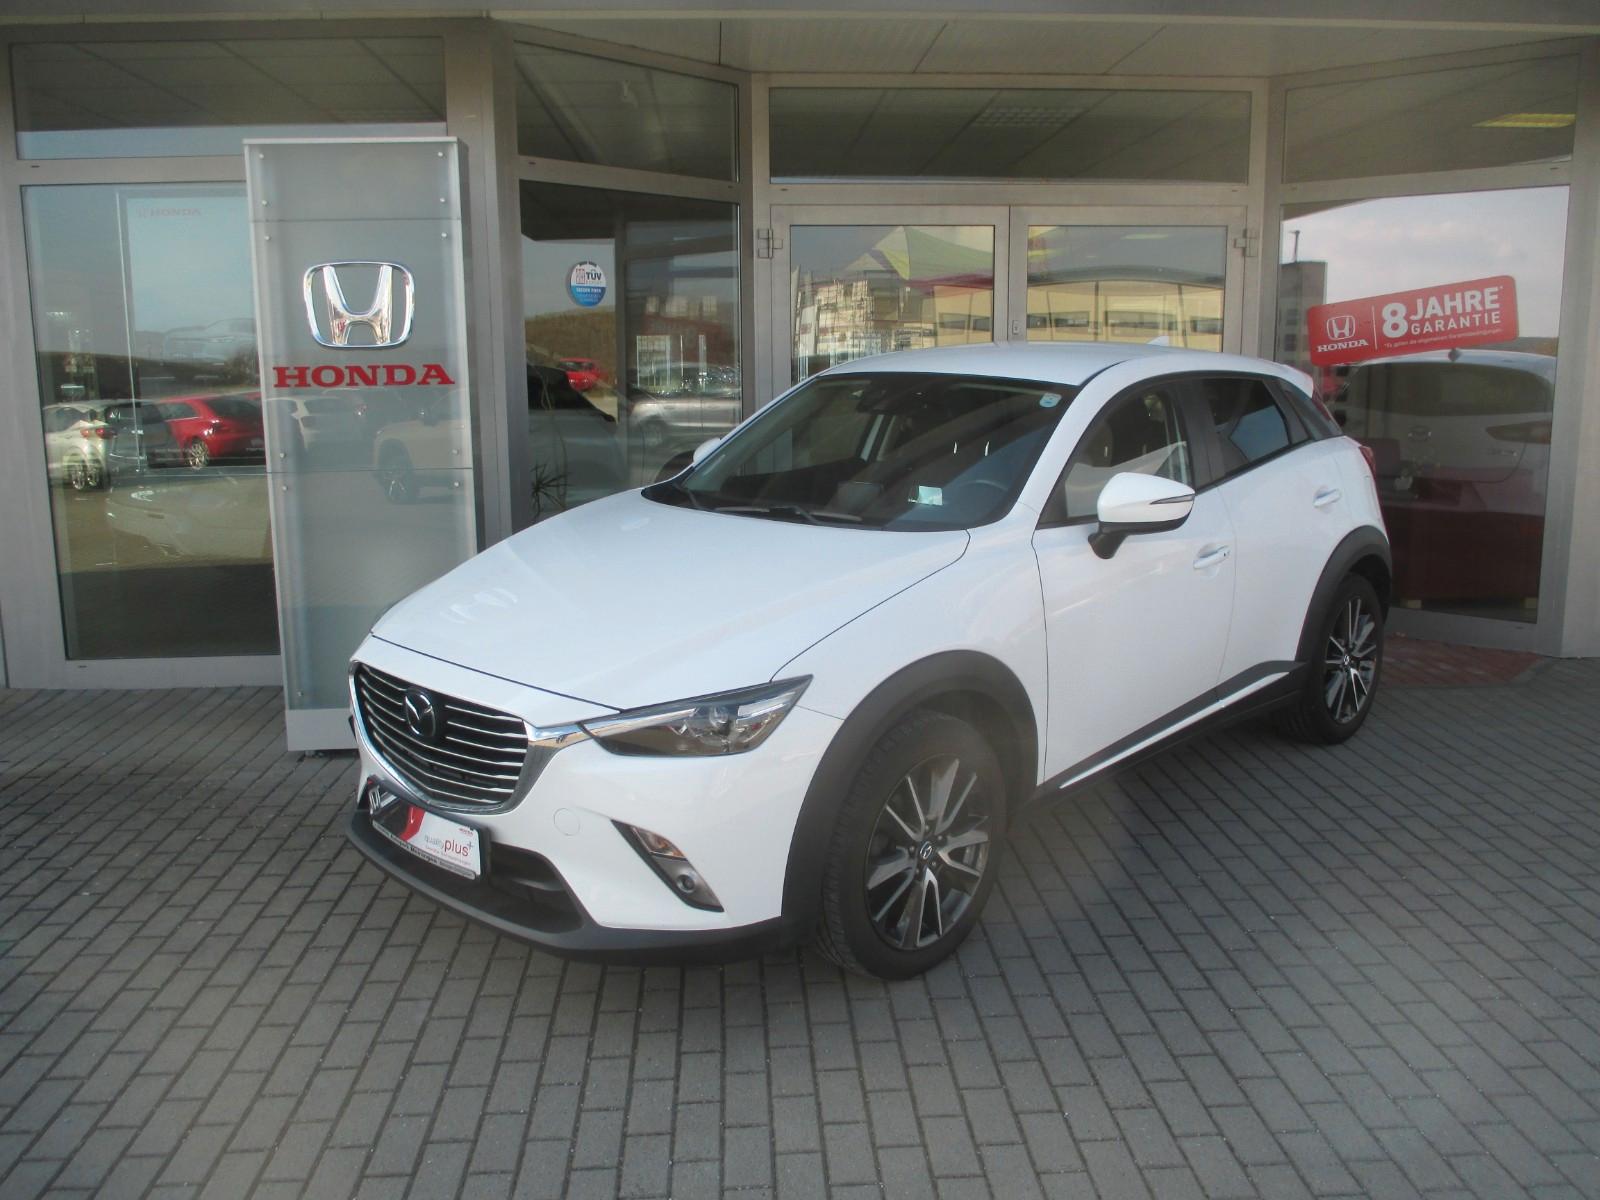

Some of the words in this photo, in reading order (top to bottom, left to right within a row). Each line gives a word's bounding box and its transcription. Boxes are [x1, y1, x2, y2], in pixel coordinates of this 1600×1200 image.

[1382, 303, 1408, 338] 8
[1410, 312, 1501, 335] GARANTIE
[1317, 339, 1369, 353] HONDA
[273, 364, 455, 388] HONDA
